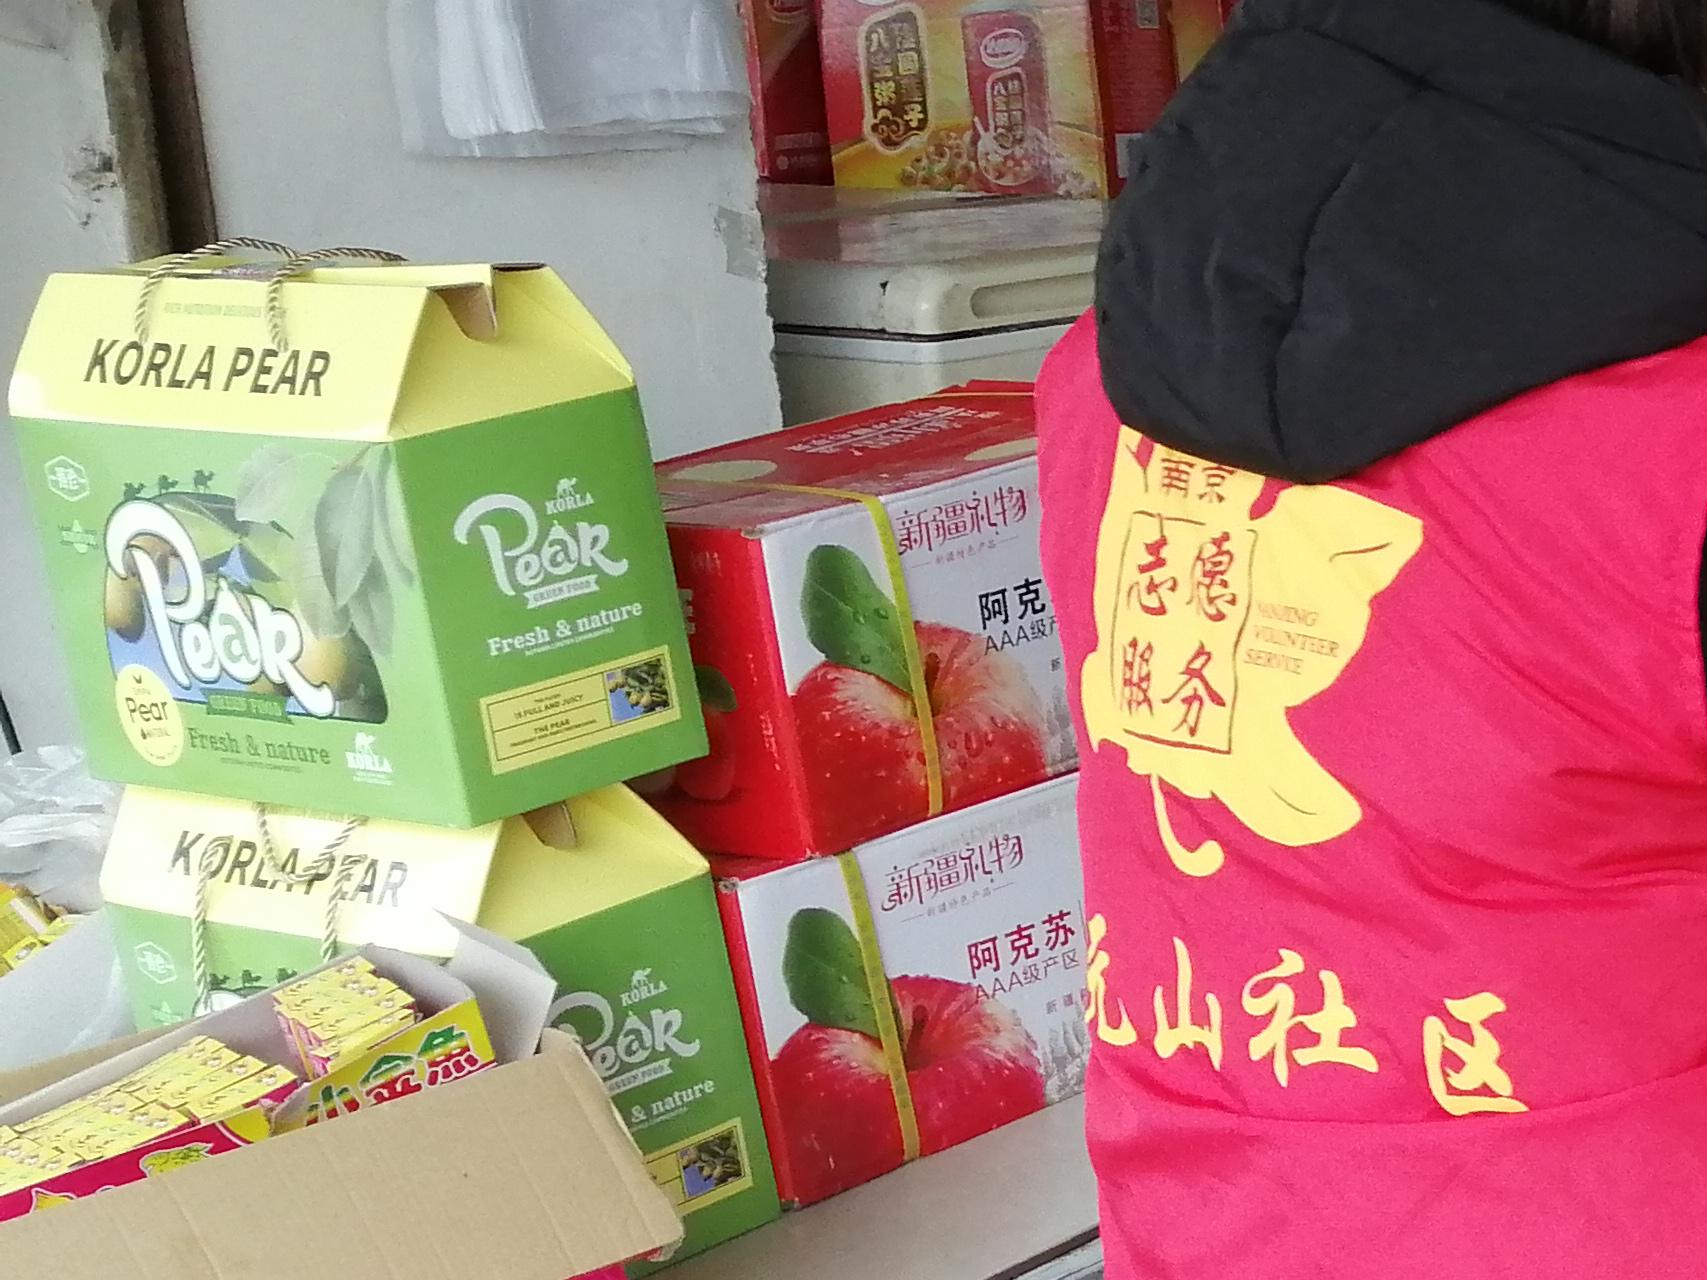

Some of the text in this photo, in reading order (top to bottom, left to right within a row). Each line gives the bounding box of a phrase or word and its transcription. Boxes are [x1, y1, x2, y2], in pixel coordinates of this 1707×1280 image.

[84, 338, 331, 396] KORLA PEAR
[545, 491, 594, 514] KORLA
[898, 486, 1028, 556] 新疆礼物
[978, 577, 1047, 631] 阿克
[1126, 531, 1238, 622] 志愿
[487, 625, 550, 657] Fresh
[556, 619, 572, 638] &
[577, 602, 643, 633] nature
[126, 697, 169, 724] Pear
[1120, 636, 1226, 738] 服务
[187, 727, 241, 753] Fresh
[247, 737, 260, 749] &
[265, 739, 332, 765] nature
[345, 751, 393, 773] KORLA
[168, 830, 300, 893] KORLA
[880, 832, 1024, 912] 新疆礼物
[967, 908, 1076, 979] 阿克苏
[619, 979, 668, 1007] KORLA
[974, 947, 1081, 1003] AAA级产区
[631, 1079, 716, 1123] & nature
